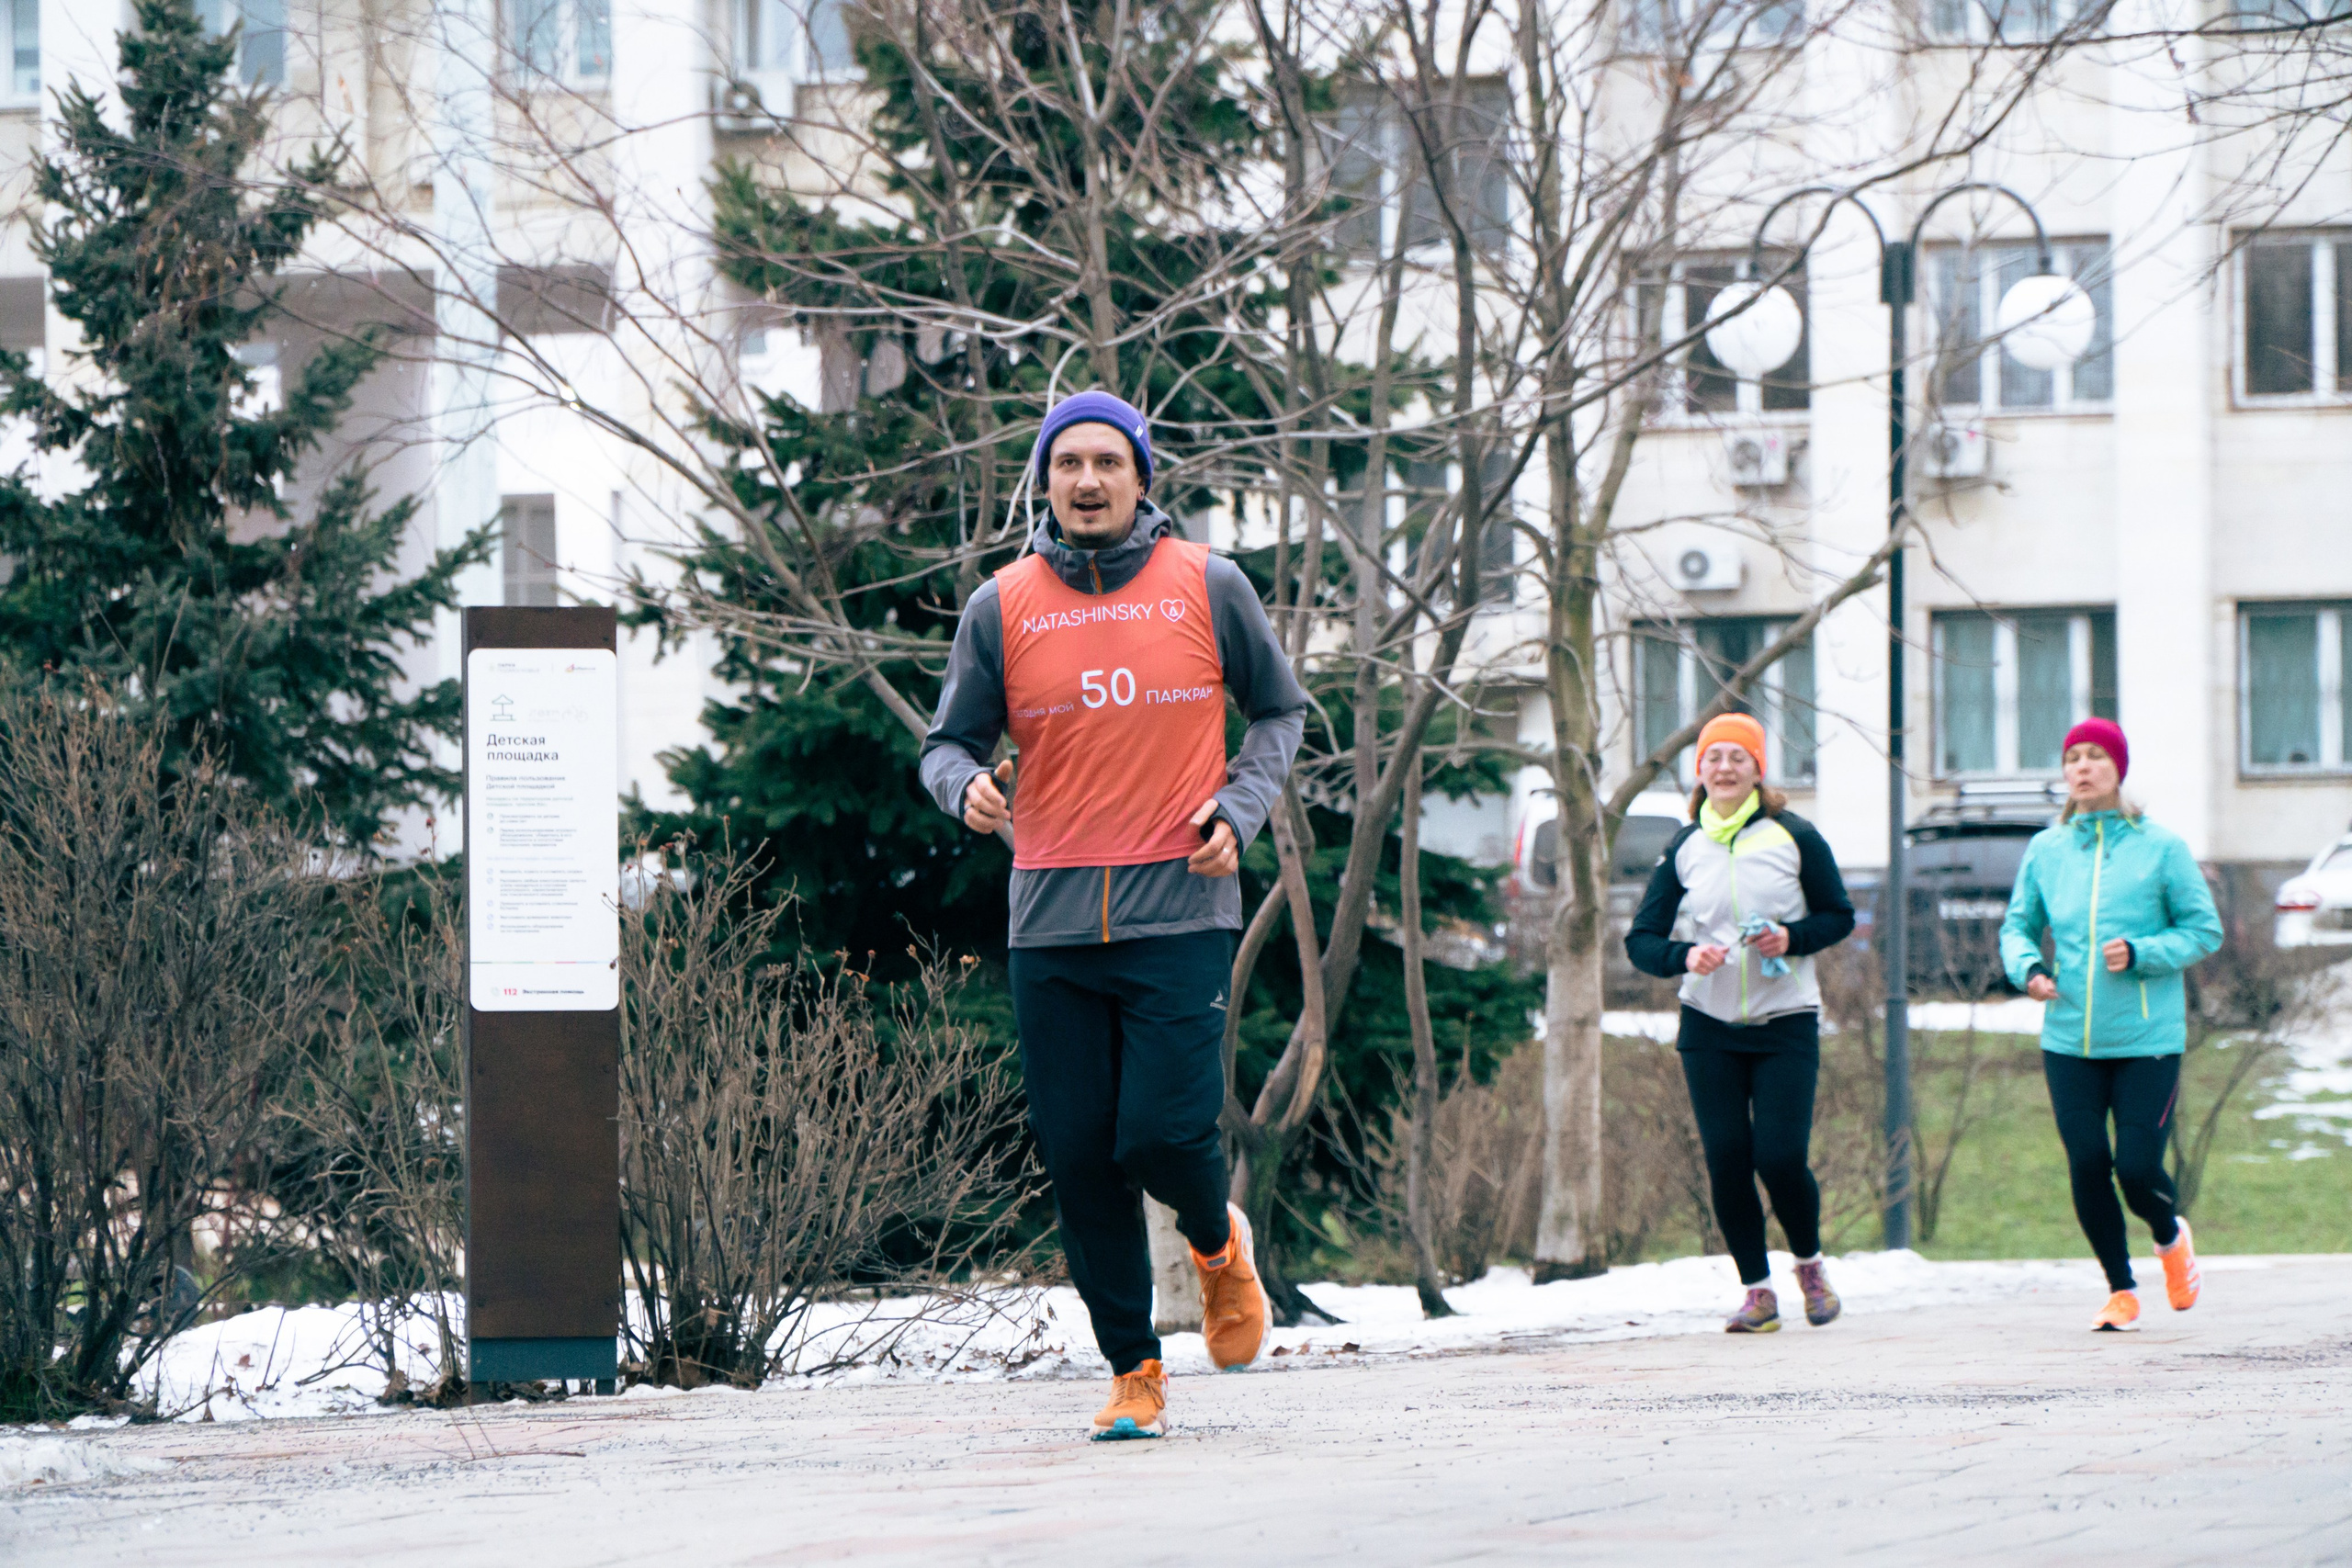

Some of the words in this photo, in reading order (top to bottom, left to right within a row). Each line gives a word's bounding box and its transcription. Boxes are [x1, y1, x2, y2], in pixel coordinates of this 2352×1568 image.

[1023, 604, 1154, 634] NATASHINSKY
[1048, 701, 1074, 715] МОЙ
[1081, 667, 1136, 709] 50
[1146, 686, 1213, 705] ПАРКРАН
[486, 734, 545, 747] Детская
[487, 751, 559, 761] площадка
